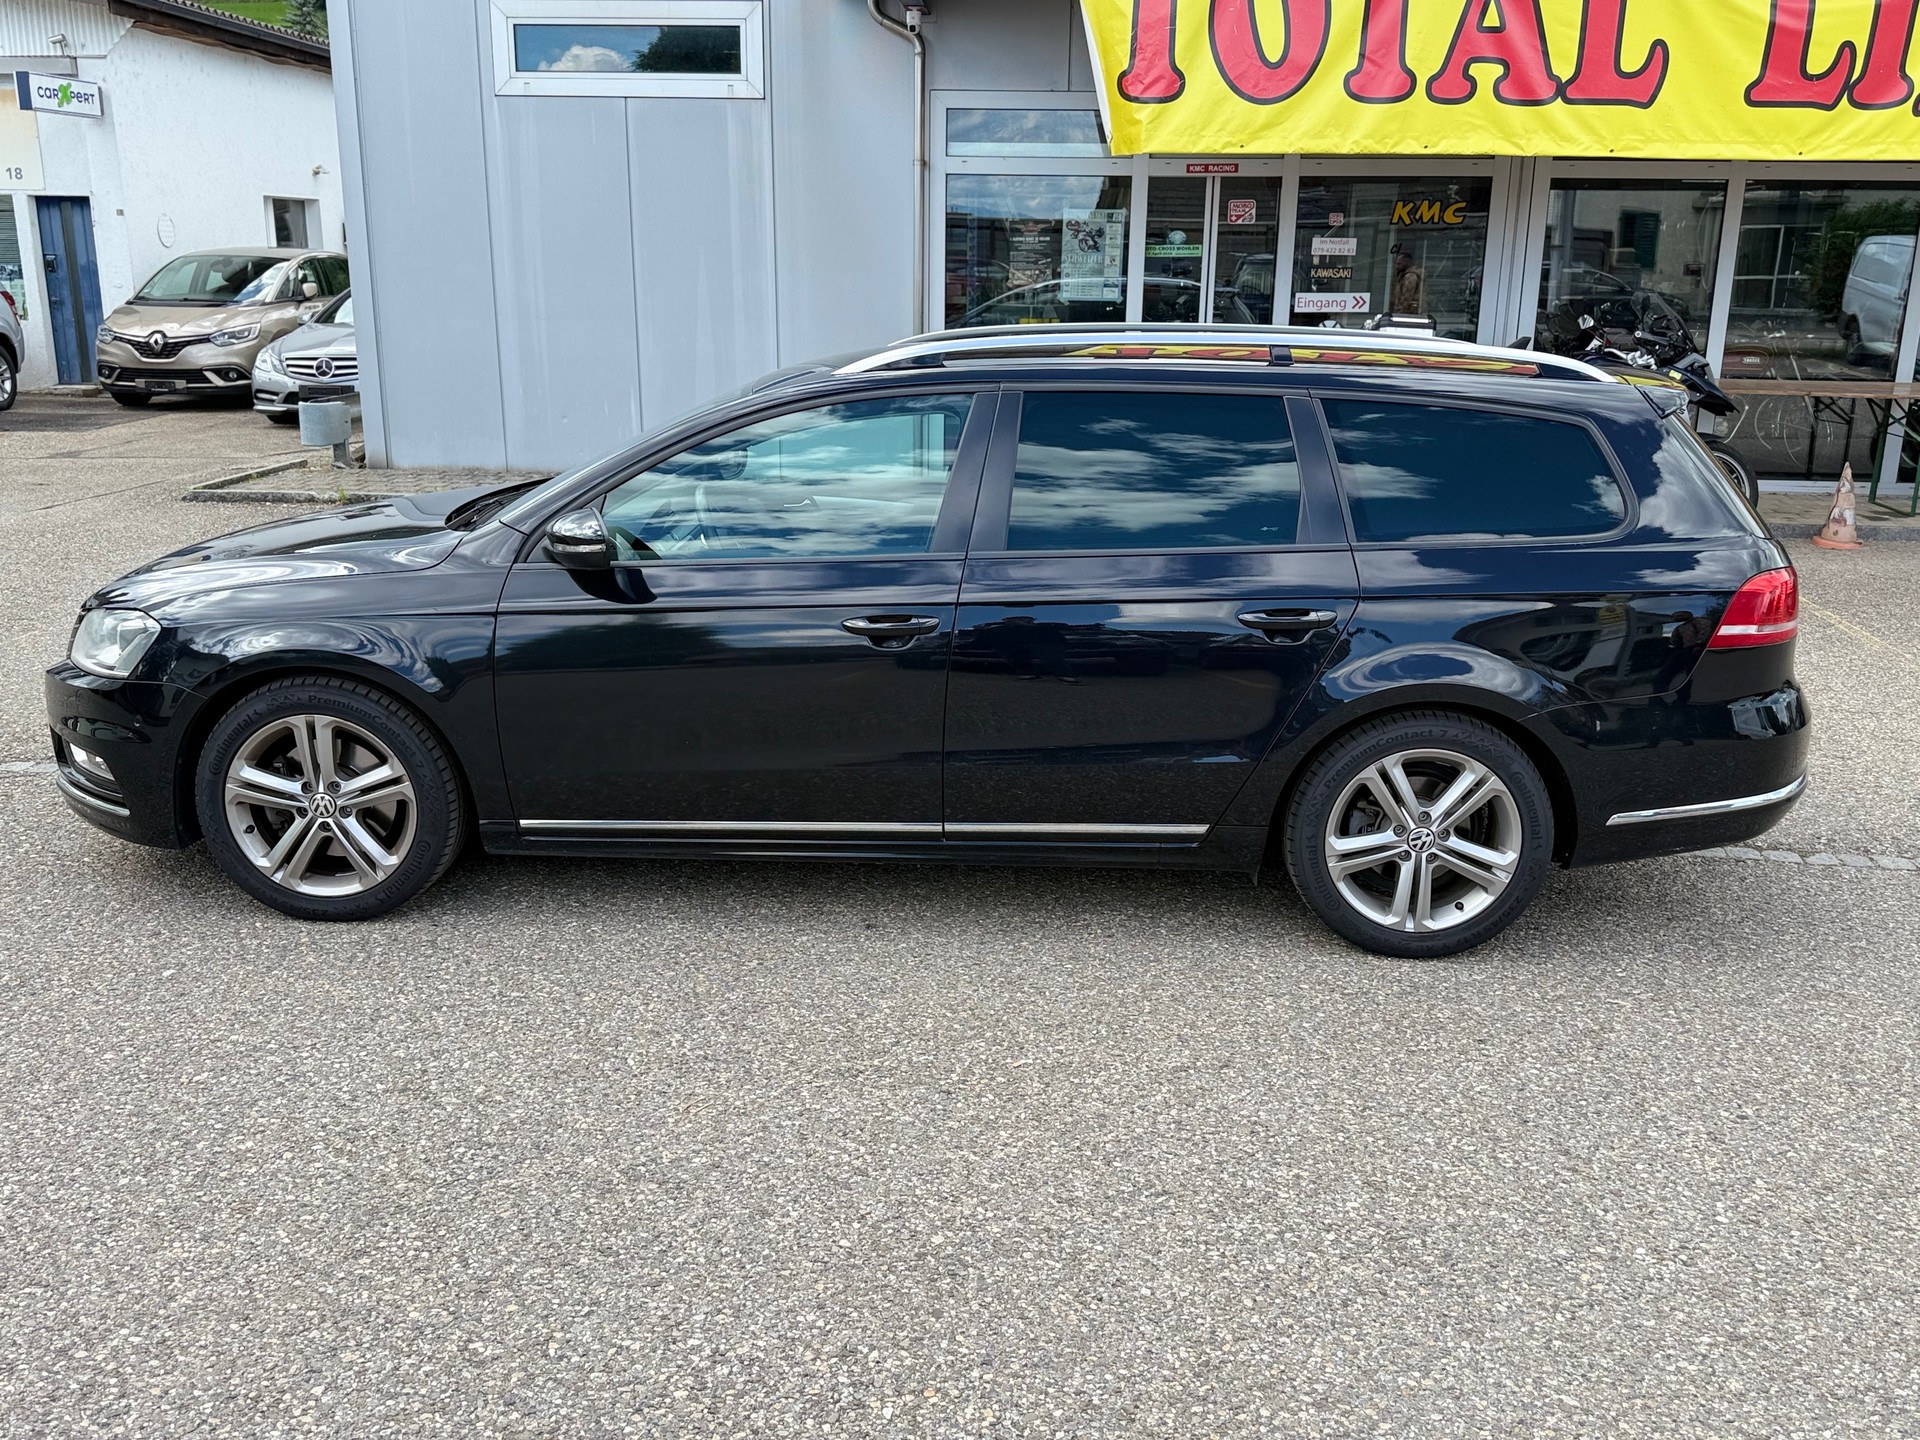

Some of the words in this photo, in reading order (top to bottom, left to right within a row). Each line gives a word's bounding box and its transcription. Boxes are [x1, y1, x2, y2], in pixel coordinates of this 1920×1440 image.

[1744, 0, 1920, 119] LI
[5, 167, 23, 180] 18
[1189, 164, 1206, 172] KMC
[1208, 164, 1236, 172] RACING
[1390, 199, 1468, 226] KMC
[1310, 268, 1352, 278] KAWASAKI
[1297, 297, 1347, 311] Eingang
[208, 713, 254, 776] Continental
[308, 694, 417, 759] PremiumContact
[1326, 729, 1434, 790] PremiumContact
[1510, 771, 1544, 841] Continental
[384, 839, 431, 900] Continental
[1303, 844, 1341, 910] Continental
